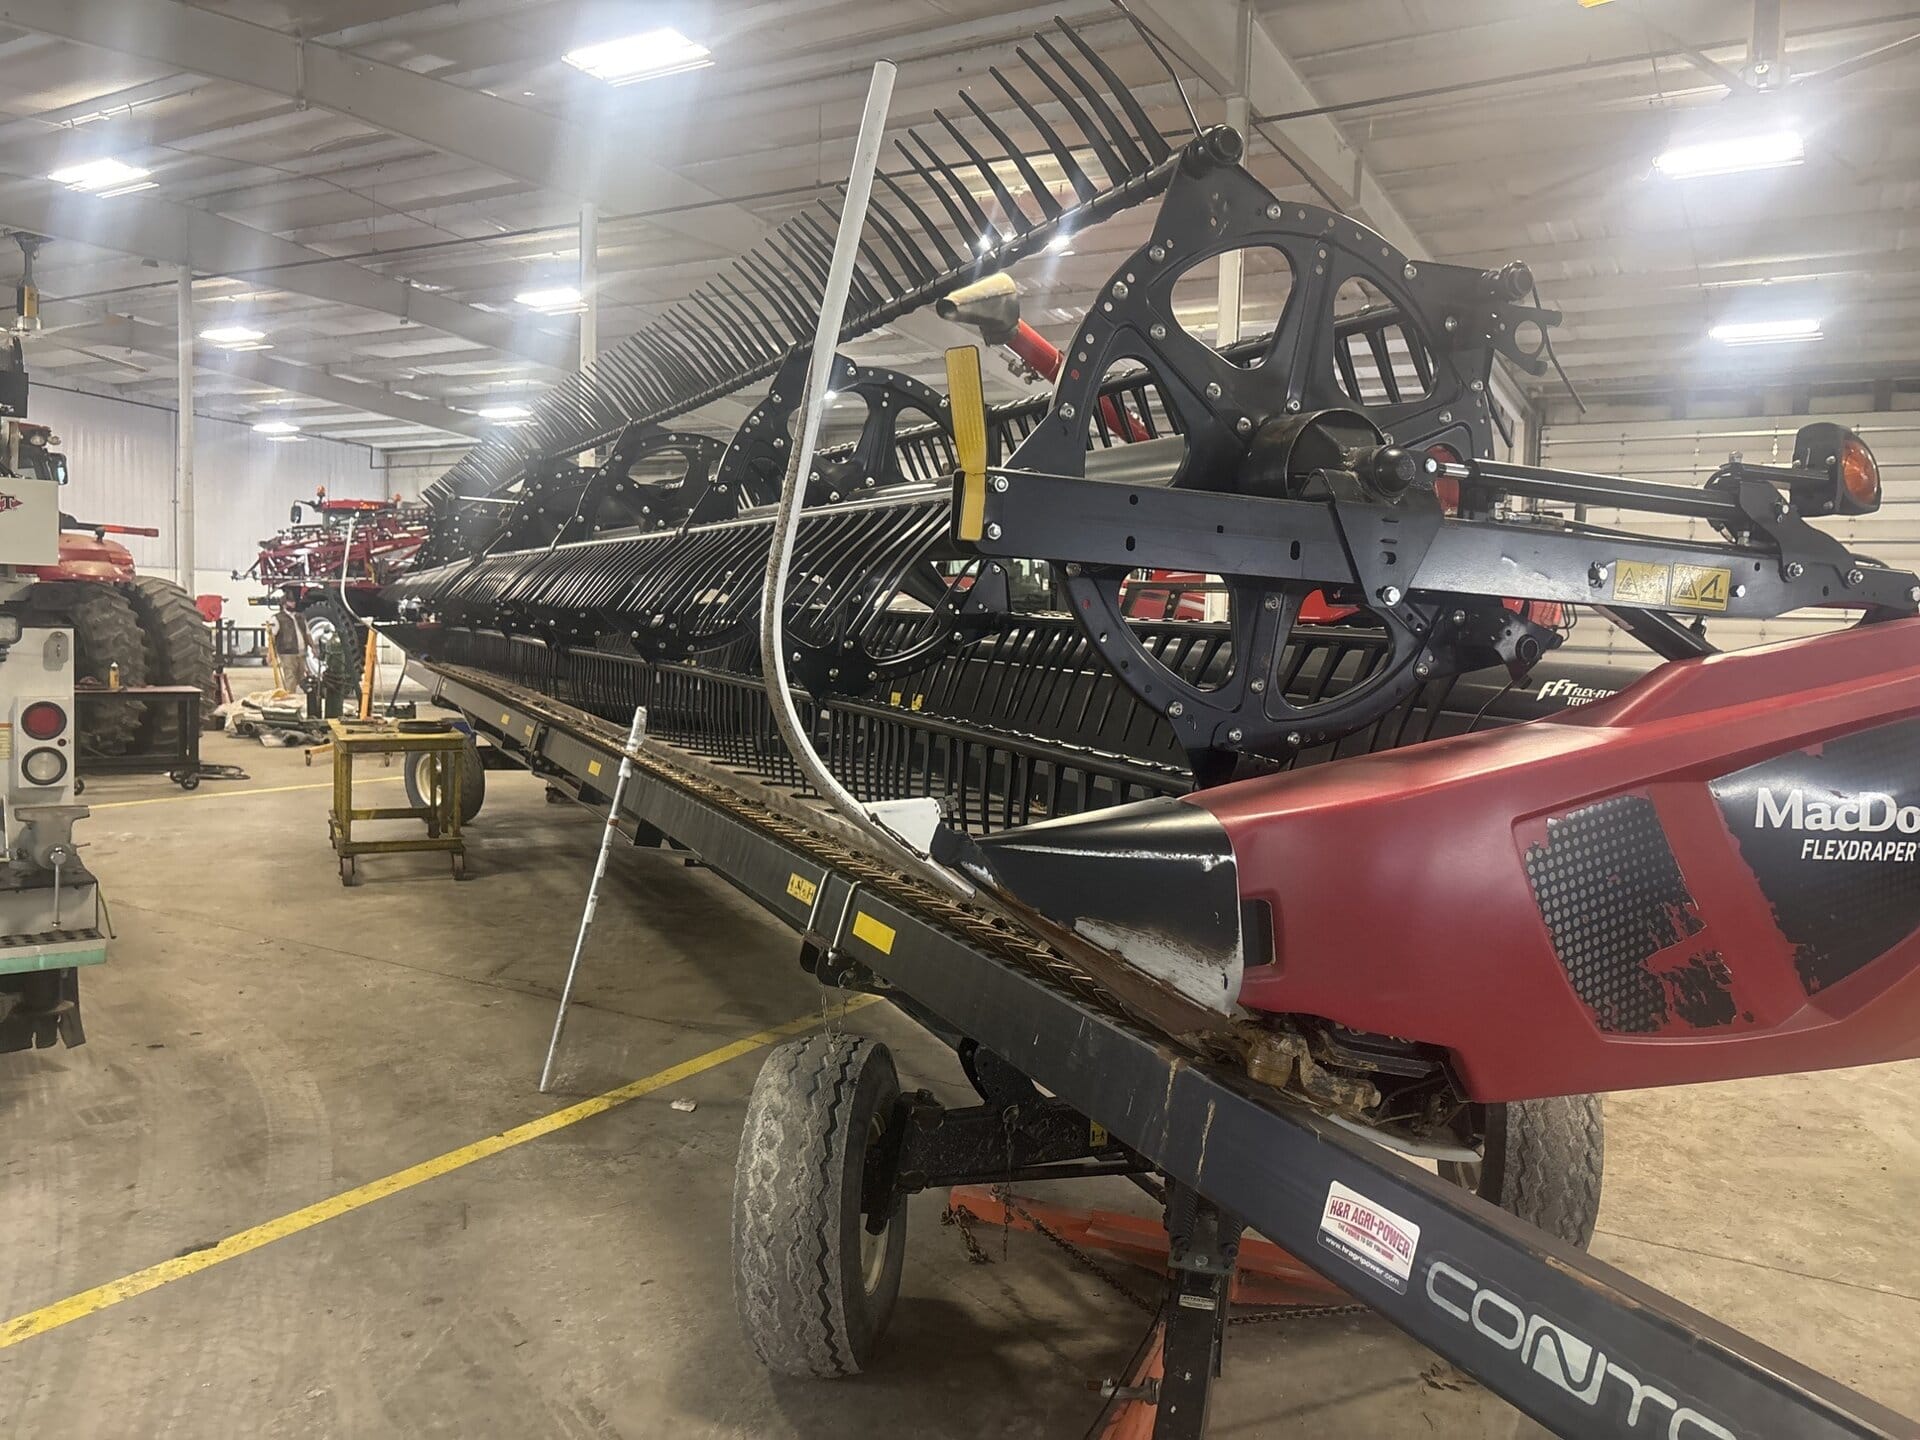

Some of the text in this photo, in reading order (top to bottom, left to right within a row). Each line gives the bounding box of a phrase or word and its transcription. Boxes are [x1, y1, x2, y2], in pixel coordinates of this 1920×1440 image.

[1536, 679, 1619, 701] FFT FLEX-FLO
[1755, 787, 1920, 833] MacDo
[1801, 839, 1916, 861] FLEXDRAPER
[1329, 1200, 1411, 1259] H&R AGRI-POWER
[1325, 1236, 1400, 1286] www.hragripower.com
